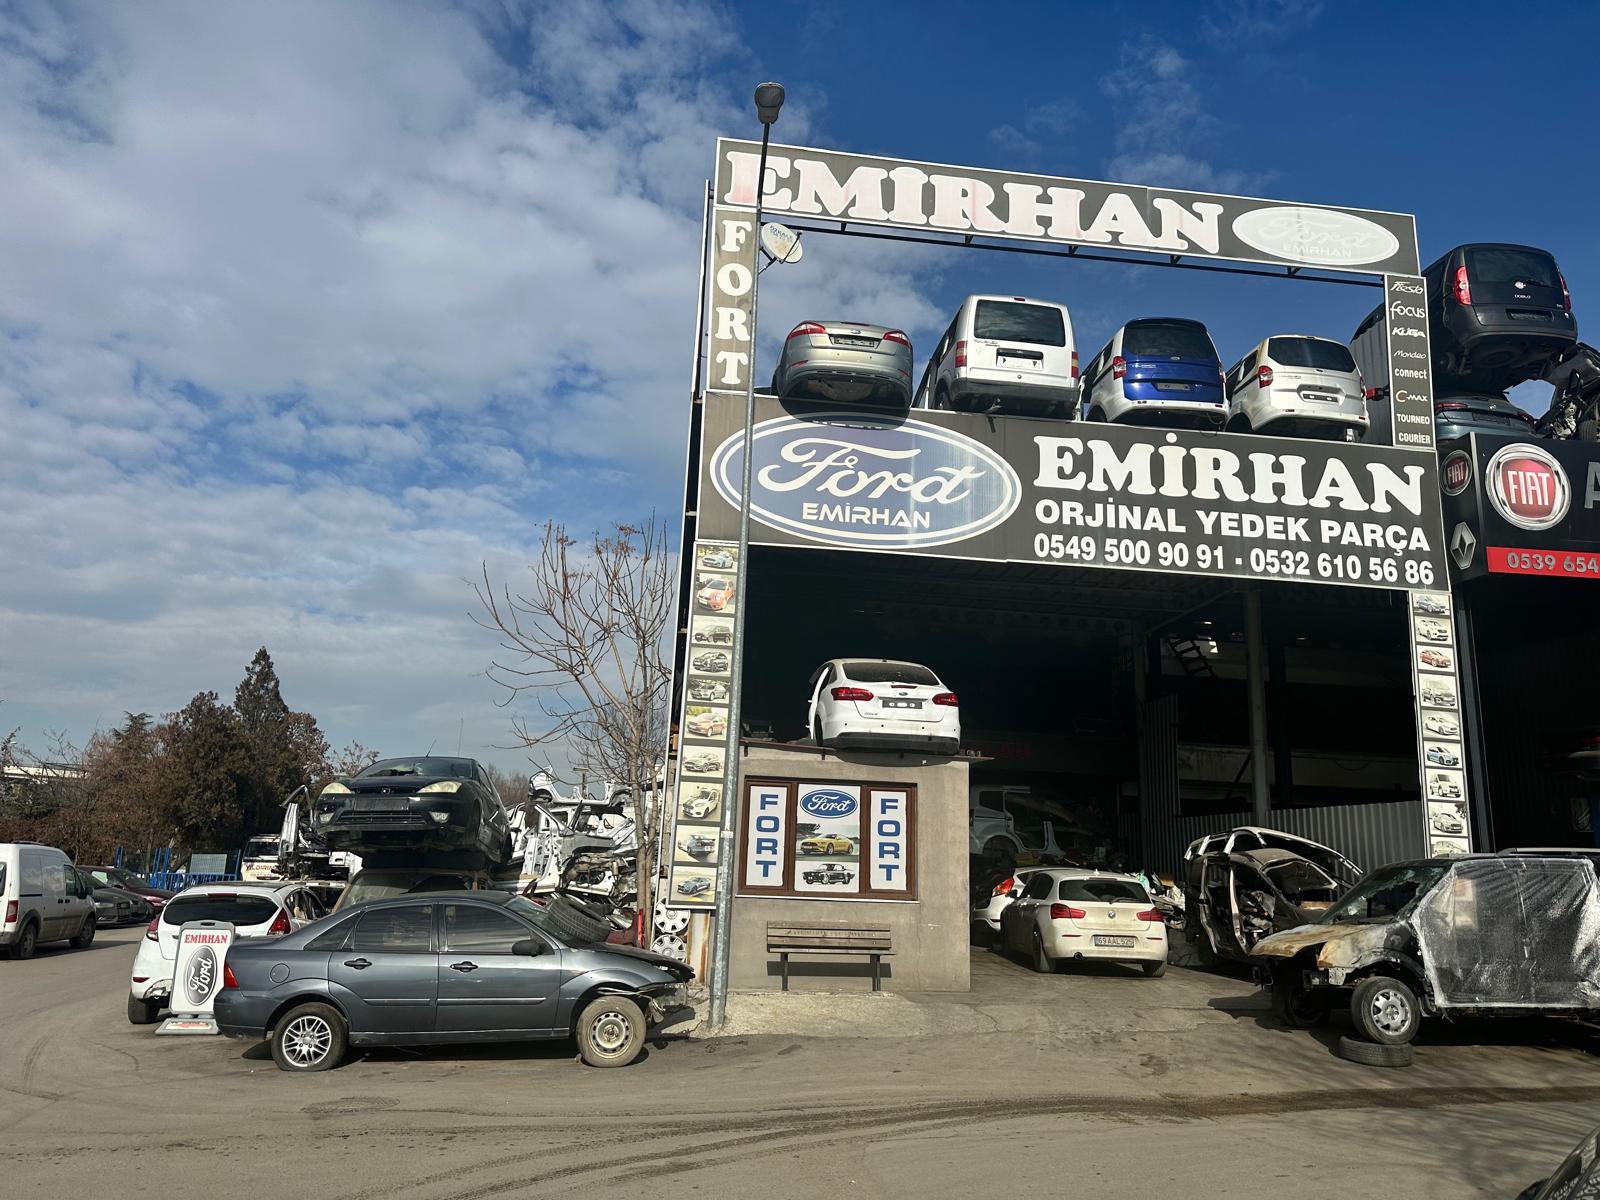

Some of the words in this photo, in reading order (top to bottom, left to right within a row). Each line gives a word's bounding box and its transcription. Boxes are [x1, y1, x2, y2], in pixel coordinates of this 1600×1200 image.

[715, 220, 752, 385] FORT
[1390, 281, 1423, 294] Fiesta
[1393, 350, 1426, 359] Mondeo
[1395, 368, 1427, 379] connect
[1396, 413, 1430, 425] TOURNEO
[758, 437, 986, 504] Ford
[1033, 432, 1425, 516] EMİRHAN
[1447, 461, 1467, 485] FIAT
[1507, 470, 1549, 506] FIAT
[802, 502, 930, 528] EMİRHAN
[1035, 497, 1187, 533] ORJİNAL
[1195, 509, 1311, 542] YEDEK
[1320, 519, 1431, 556] PARÇA
[1034, 533, 1096, 560] 0549
[1104, 538, 1150, 565] 500
[1158, 541, 1189, 567] 90
[1196, 544, 1224, 569] 91
[1250, 548, 1310, 576] 0532
[1317, 553, 1362, 580] 610
[1369, 557, 1398, 582] 56
[1405, 559, 1434, 585] 86
[1507, 552, 1556, 570] 0539
[1563, 556, 1599, 573] 654
[807, 794, 852, 812] Ford
[756, 793, 780, 877] FORT
[877, 798, 901, 881] FORT
[188, 957, 213, 994] Ford
